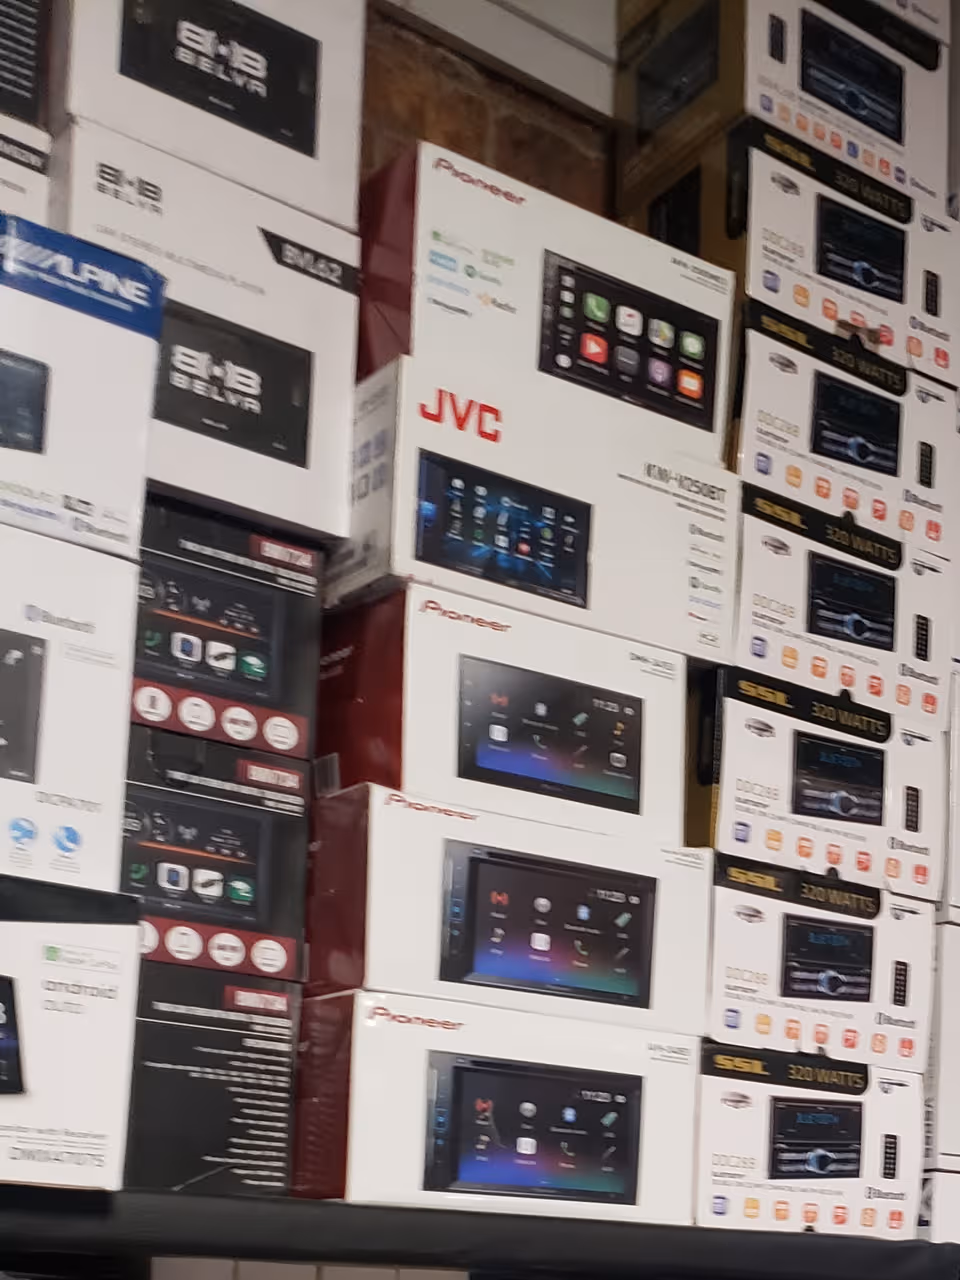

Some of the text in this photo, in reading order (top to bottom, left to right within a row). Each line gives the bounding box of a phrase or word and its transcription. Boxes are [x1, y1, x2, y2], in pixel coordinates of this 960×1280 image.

[418, 388, 502, 444] JVC
[418, 599, 512, 633] Pioneer
[838, 710, 887, 736] WATTS
[384, 793, 480, 821] Pioneer
[367, 1006, 466, 1031] Pioneer
[712, 1054, 865, 1090] SSL 320 WATTS
